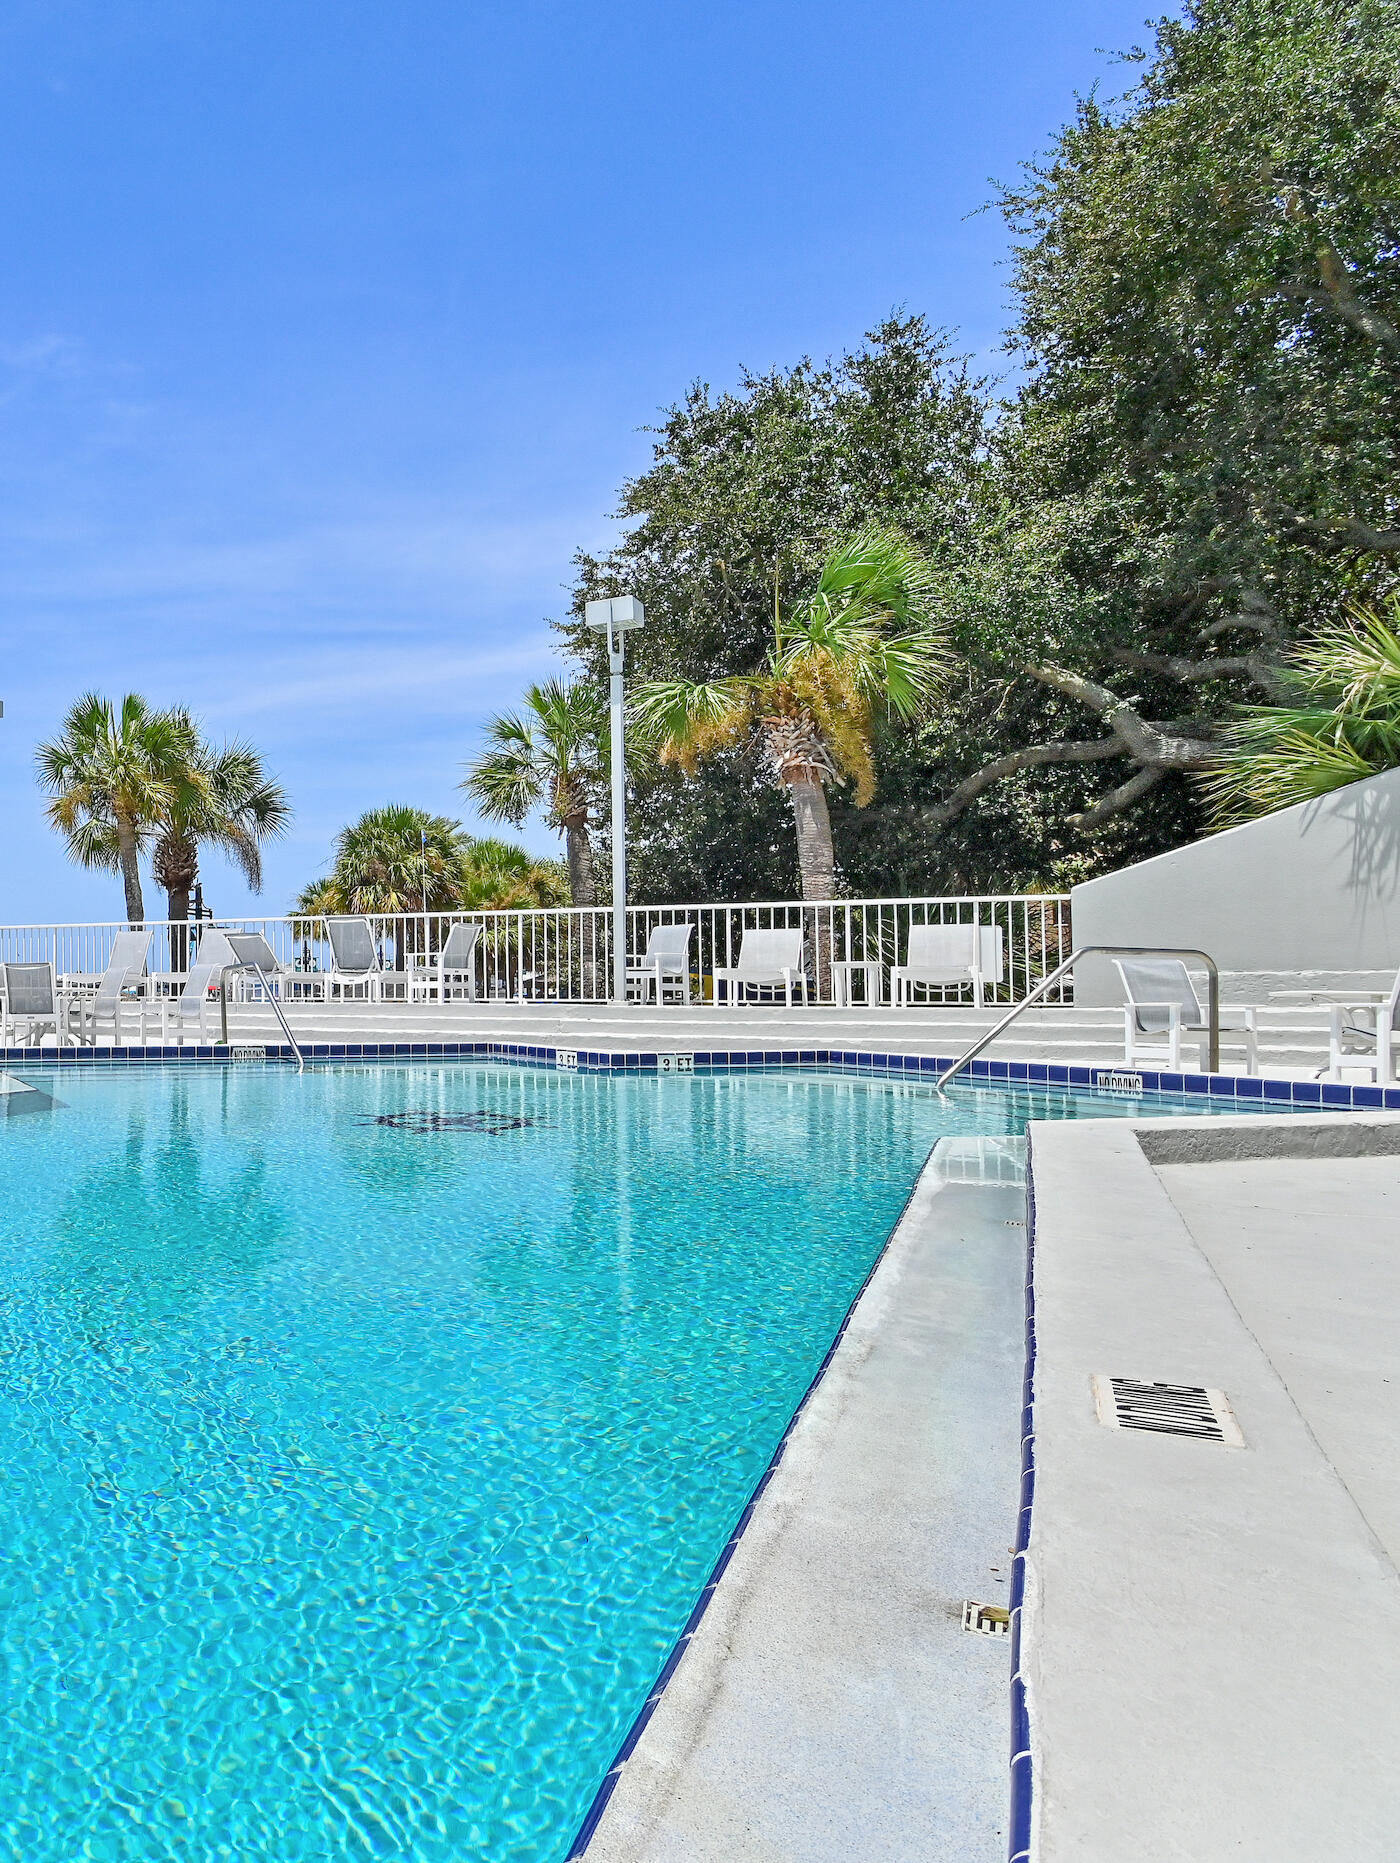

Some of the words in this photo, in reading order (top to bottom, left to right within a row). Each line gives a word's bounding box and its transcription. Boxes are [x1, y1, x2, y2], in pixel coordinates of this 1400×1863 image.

[663, 1058, 670, 1069] 3
[1098, 1076, 1110, 1088] NO
[1111, 1077, 1140, 1090] DIVING
